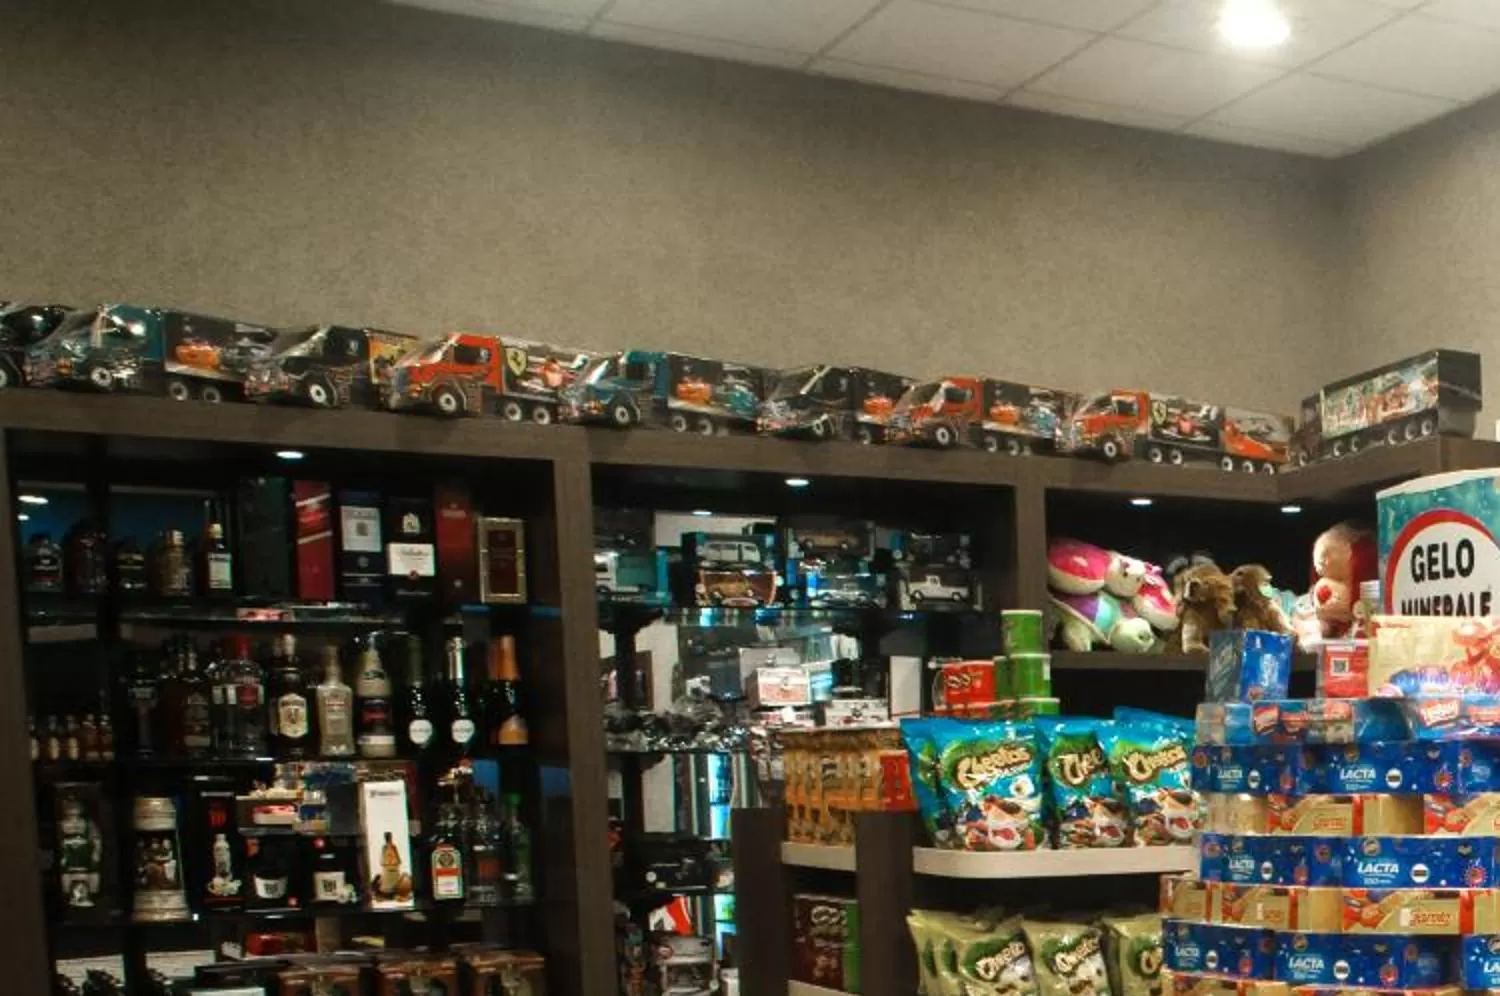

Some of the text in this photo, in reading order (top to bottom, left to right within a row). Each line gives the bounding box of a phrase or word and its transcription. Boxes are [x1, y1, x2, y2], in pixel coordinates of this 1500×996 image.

[1411, 538, 1475, 583] GELO
[957, 746, 1031, 789] Cheetos
[1339, 767, 1376, 779] LACTA
[1357, 861, 1399, 874] LACTA
[1288, 956, 1325, 969] LACTA
